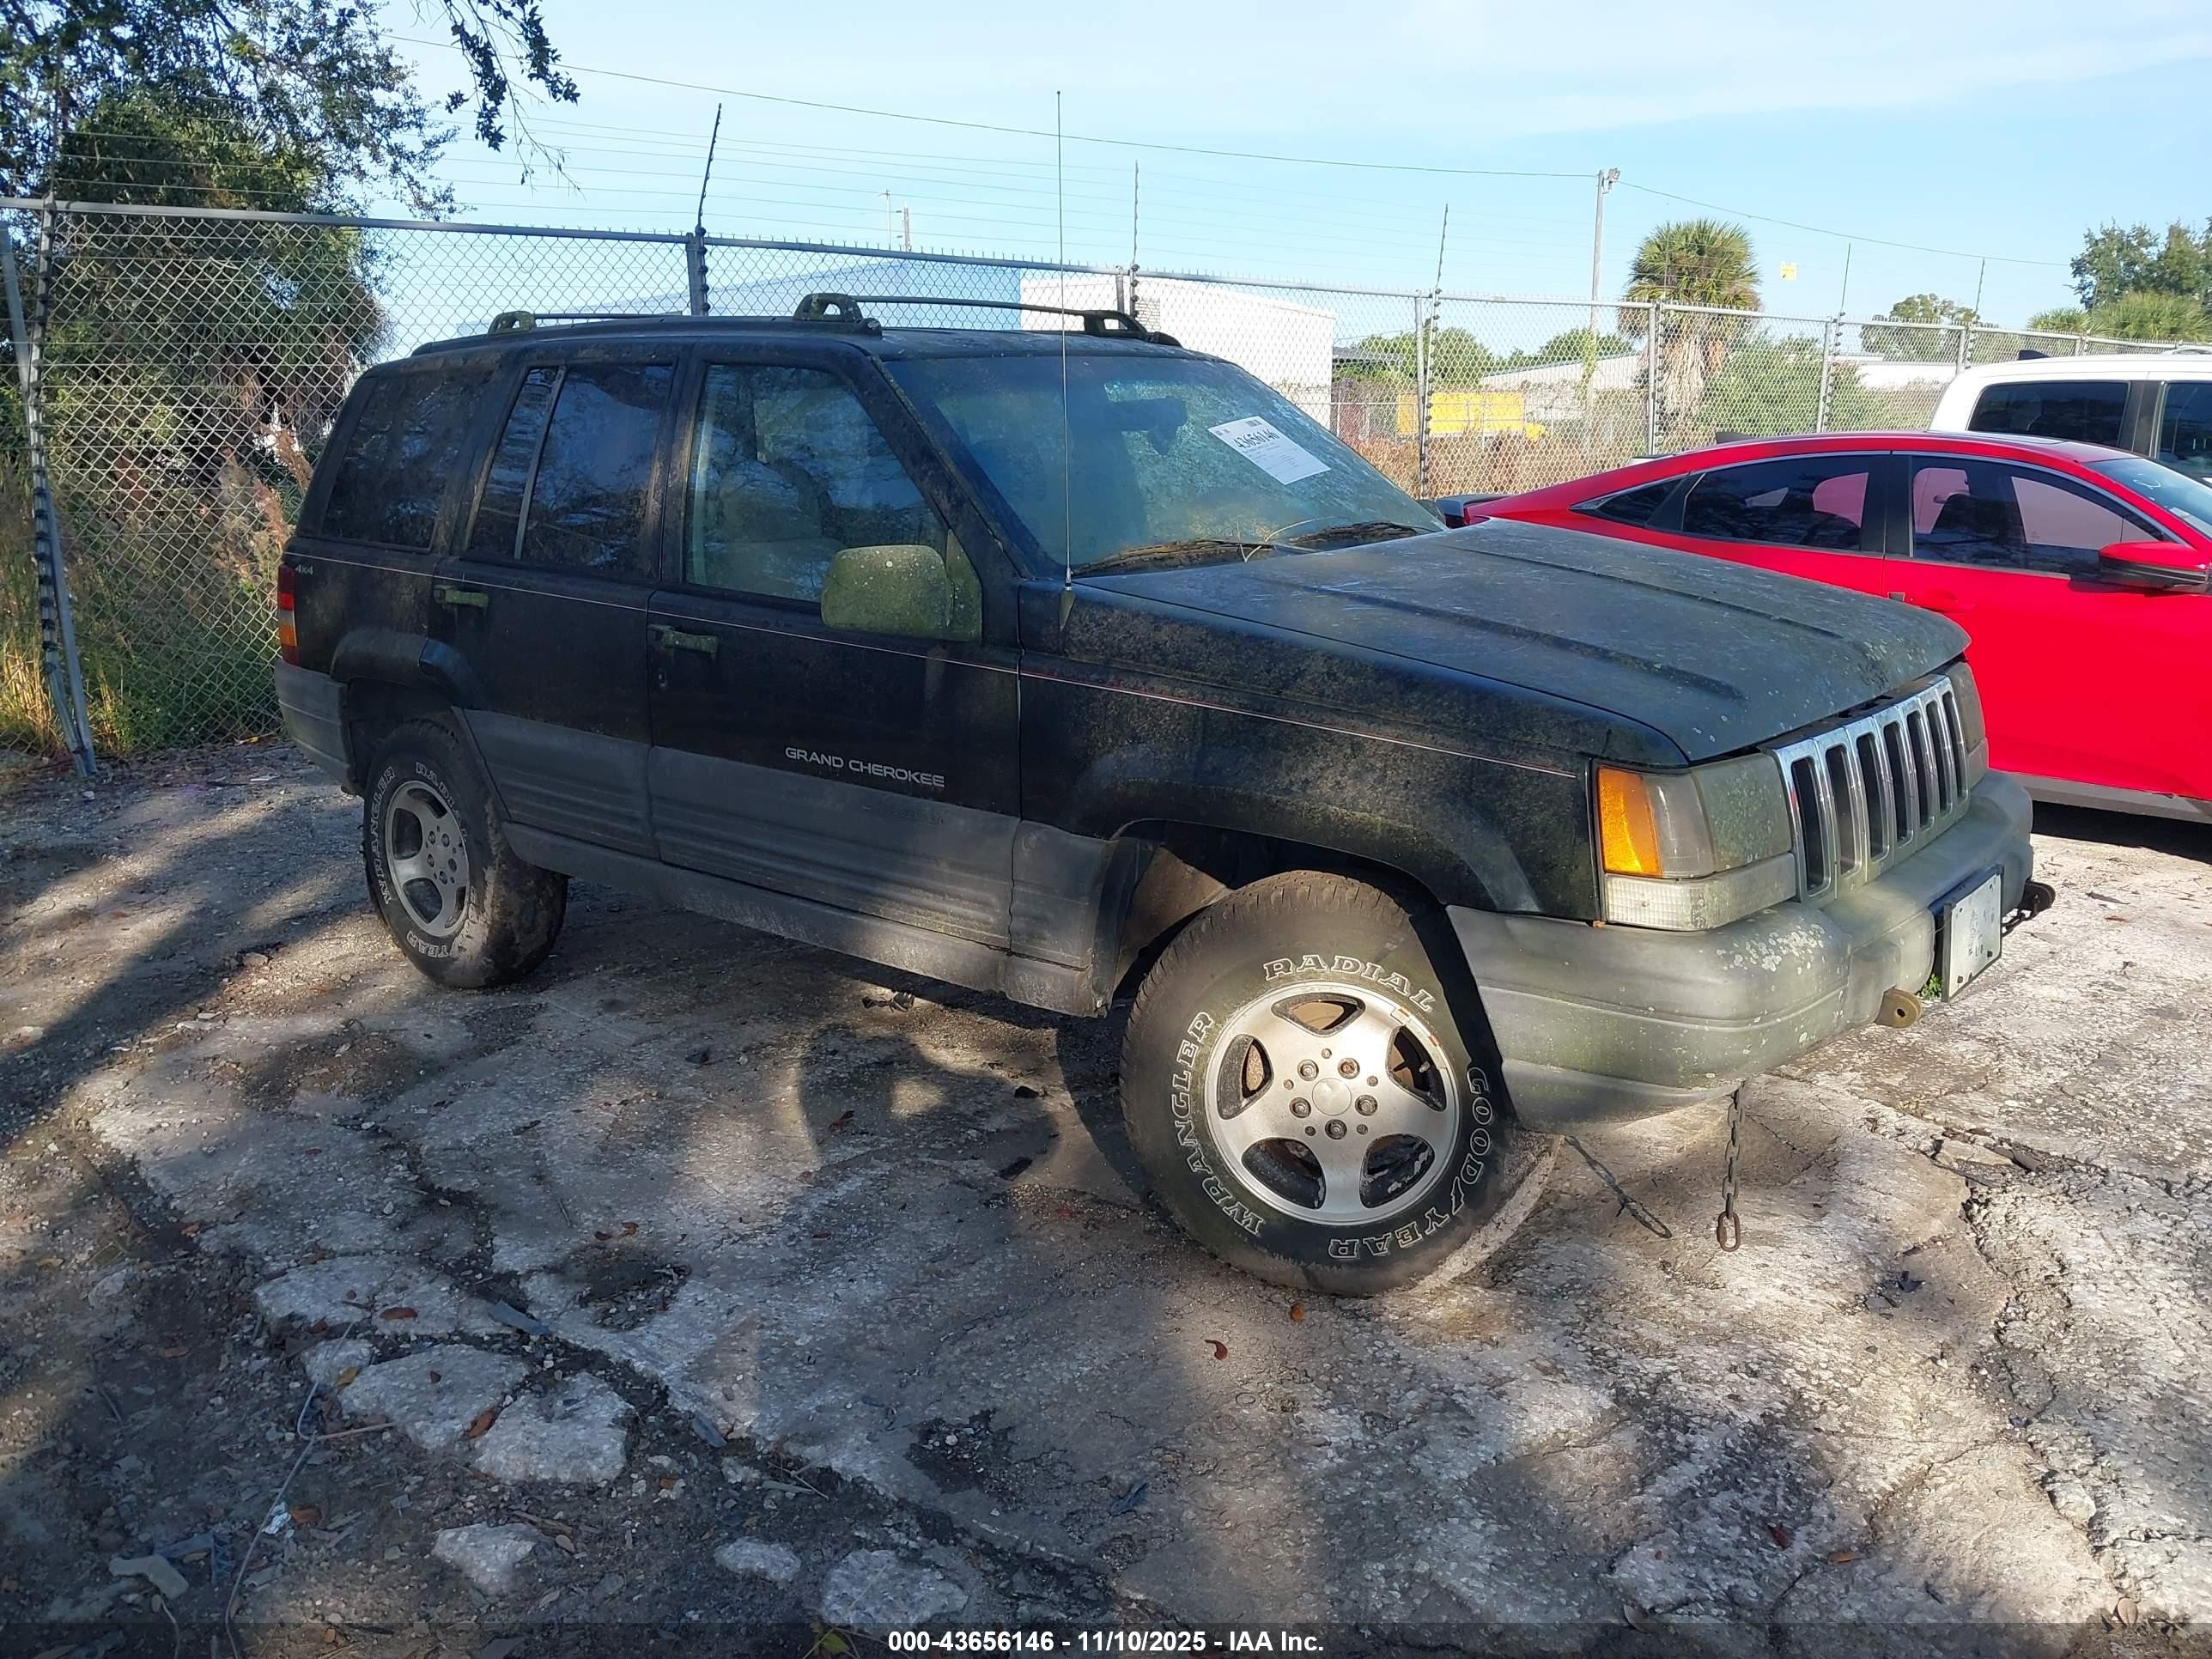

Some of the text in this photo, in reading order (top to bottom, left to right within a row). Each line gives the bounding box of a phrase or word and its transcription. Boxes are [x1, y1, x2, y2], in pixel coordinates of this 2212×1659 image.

[1233, 428, 1280, 449] 43656146
[785, 747, 945, 788] GRAND CHEROKEE
[1263, 954, 1435, 1012] RADIAL
[1170, 1011, 1265, 1236] WRANGLER
